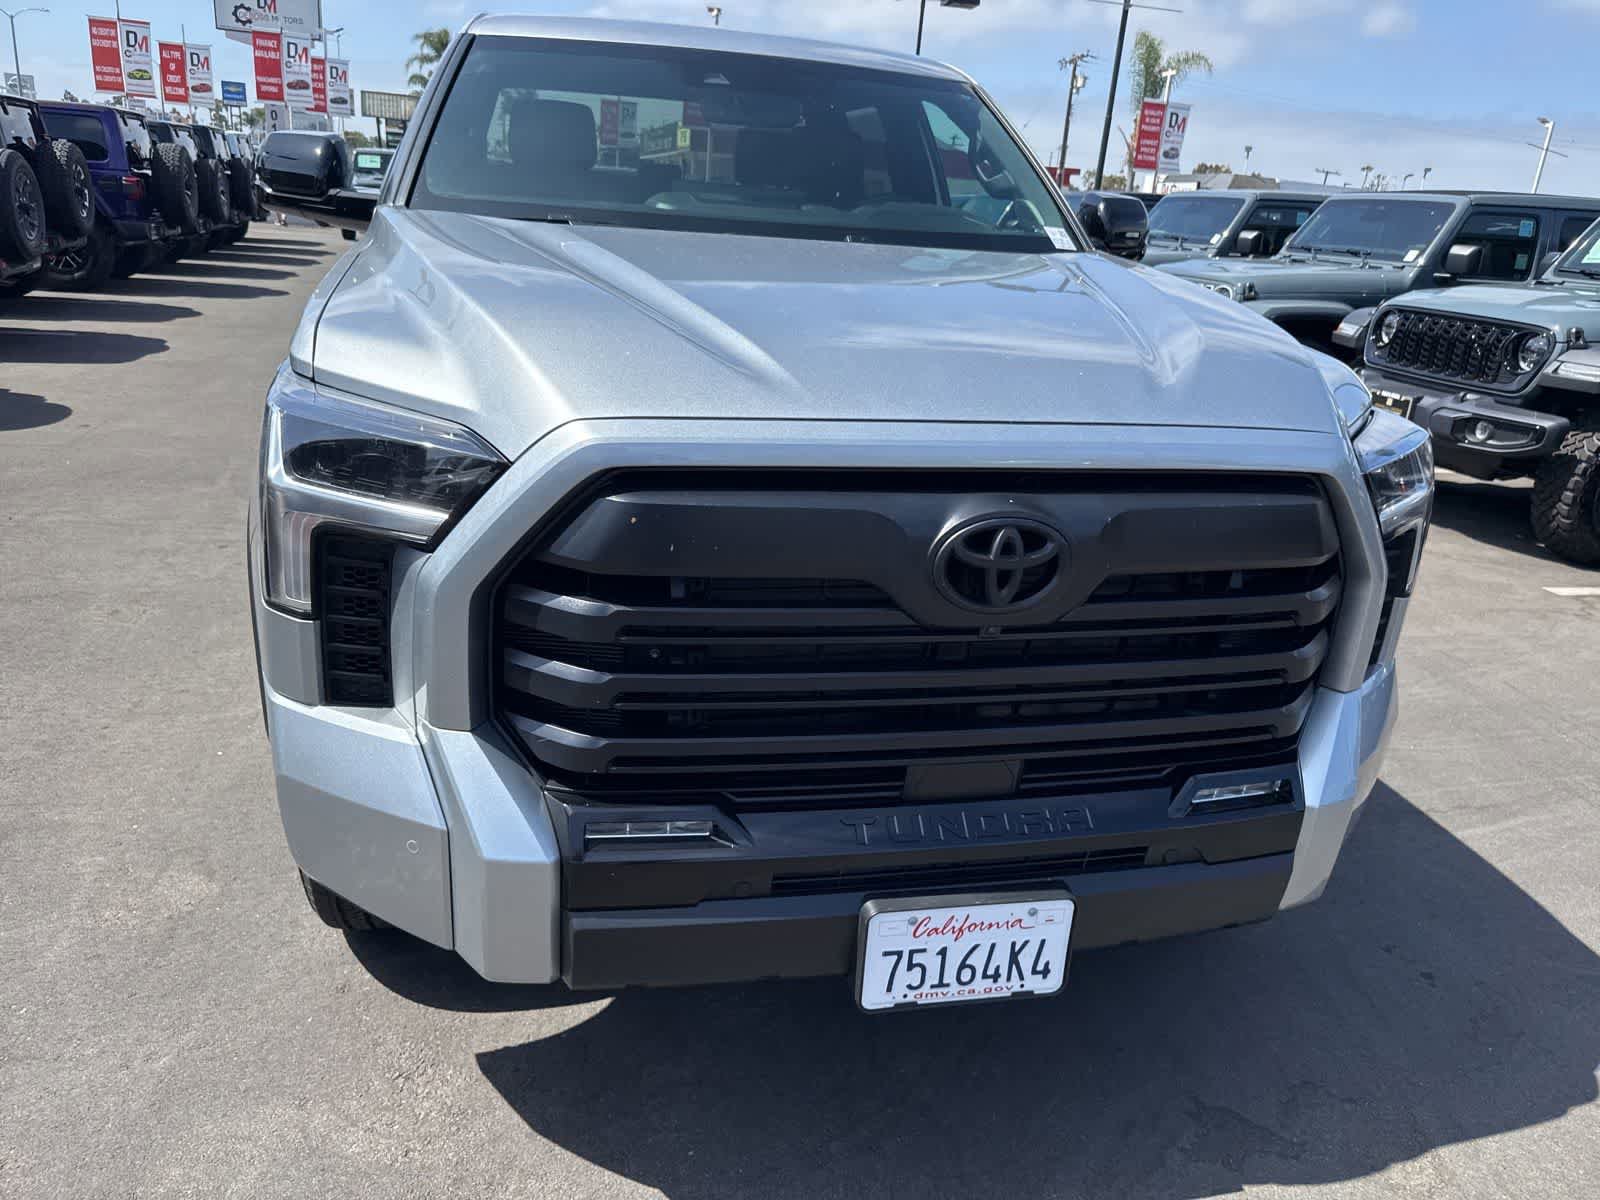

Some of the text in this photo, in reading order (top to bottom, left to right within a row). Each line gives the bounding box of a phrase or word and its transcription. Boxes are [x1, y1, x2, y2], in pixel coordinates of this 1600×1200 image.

[165, 86, 185, 97] WELCOME
[839, 805, 1095, 845] TUNDRA
[912, 915, 1035, 942] California
[881, 939, 1051, 993] 75164K4
[913, 985, 1014, 1000] dmv.ca.gov
